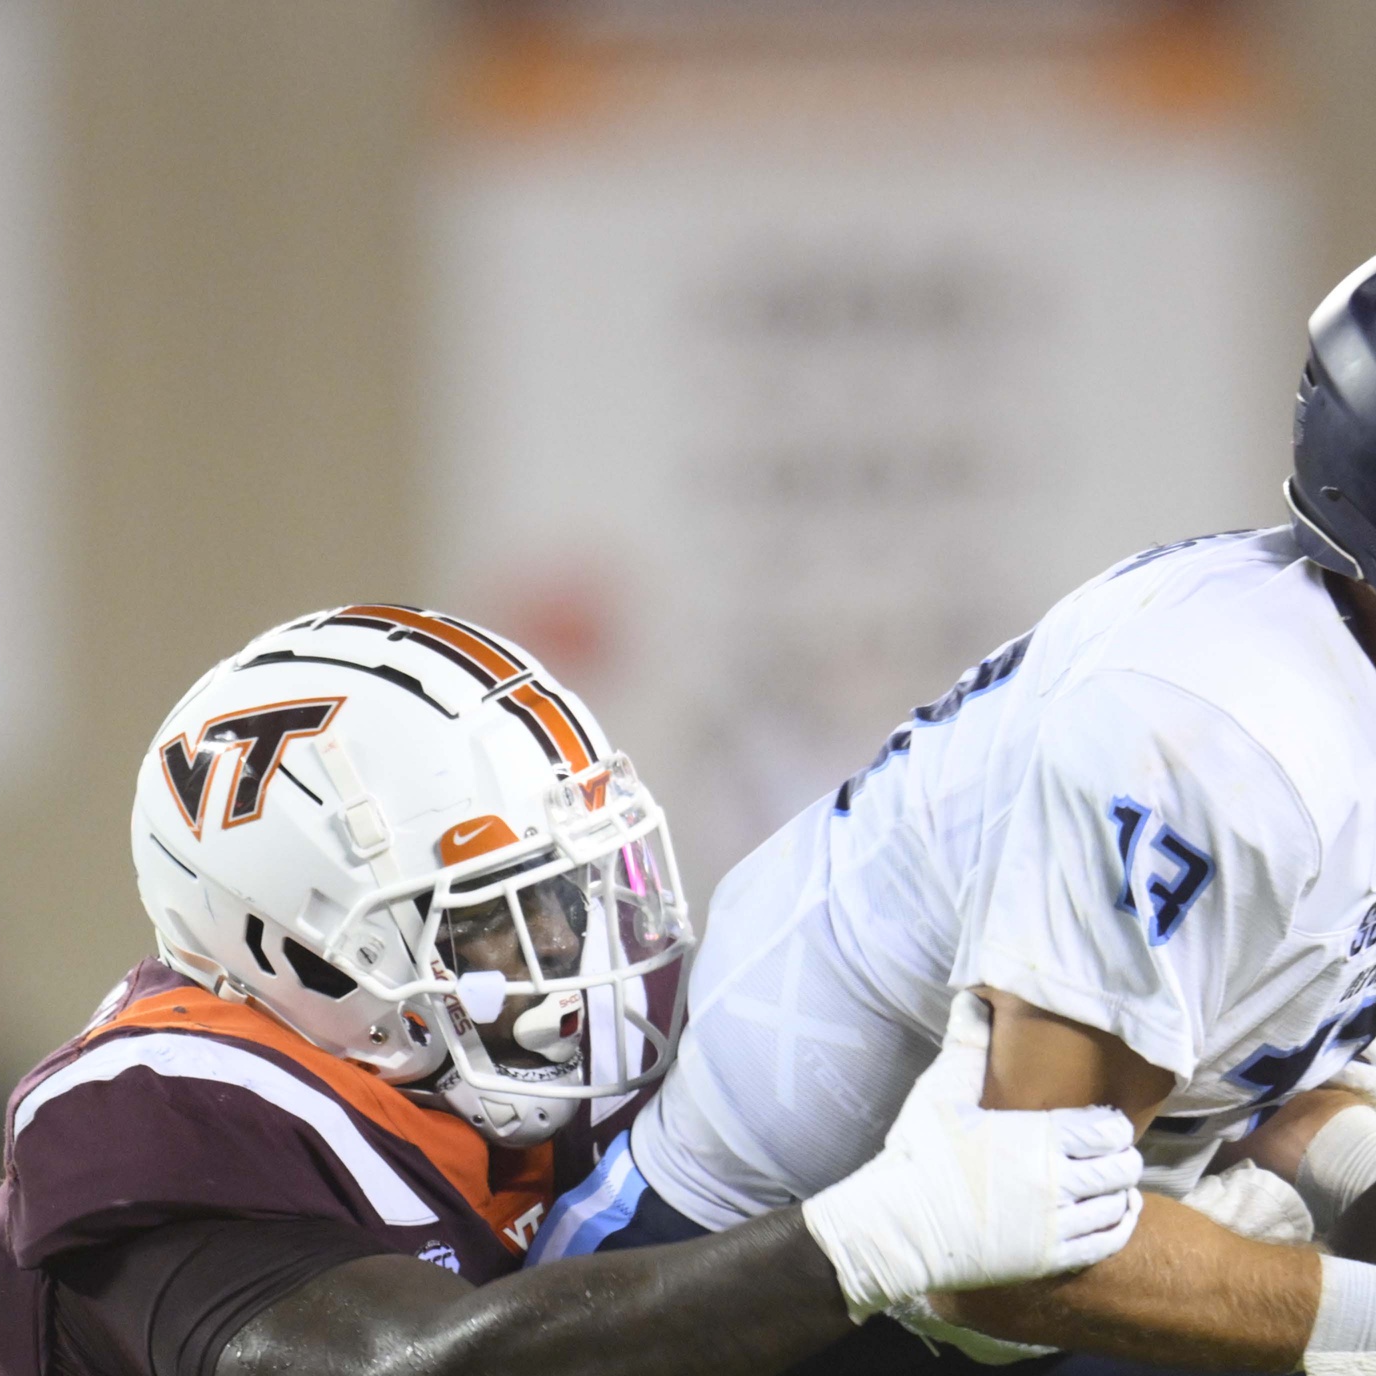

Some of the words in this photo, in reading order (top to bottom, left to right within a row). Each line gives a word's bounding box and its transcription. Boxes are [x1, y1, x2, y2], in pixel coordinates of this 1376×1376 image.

[159, 696, 347, 842] VT
[577, 769, 613, 812] VT
[502, 1202, 545, 1252] VT
